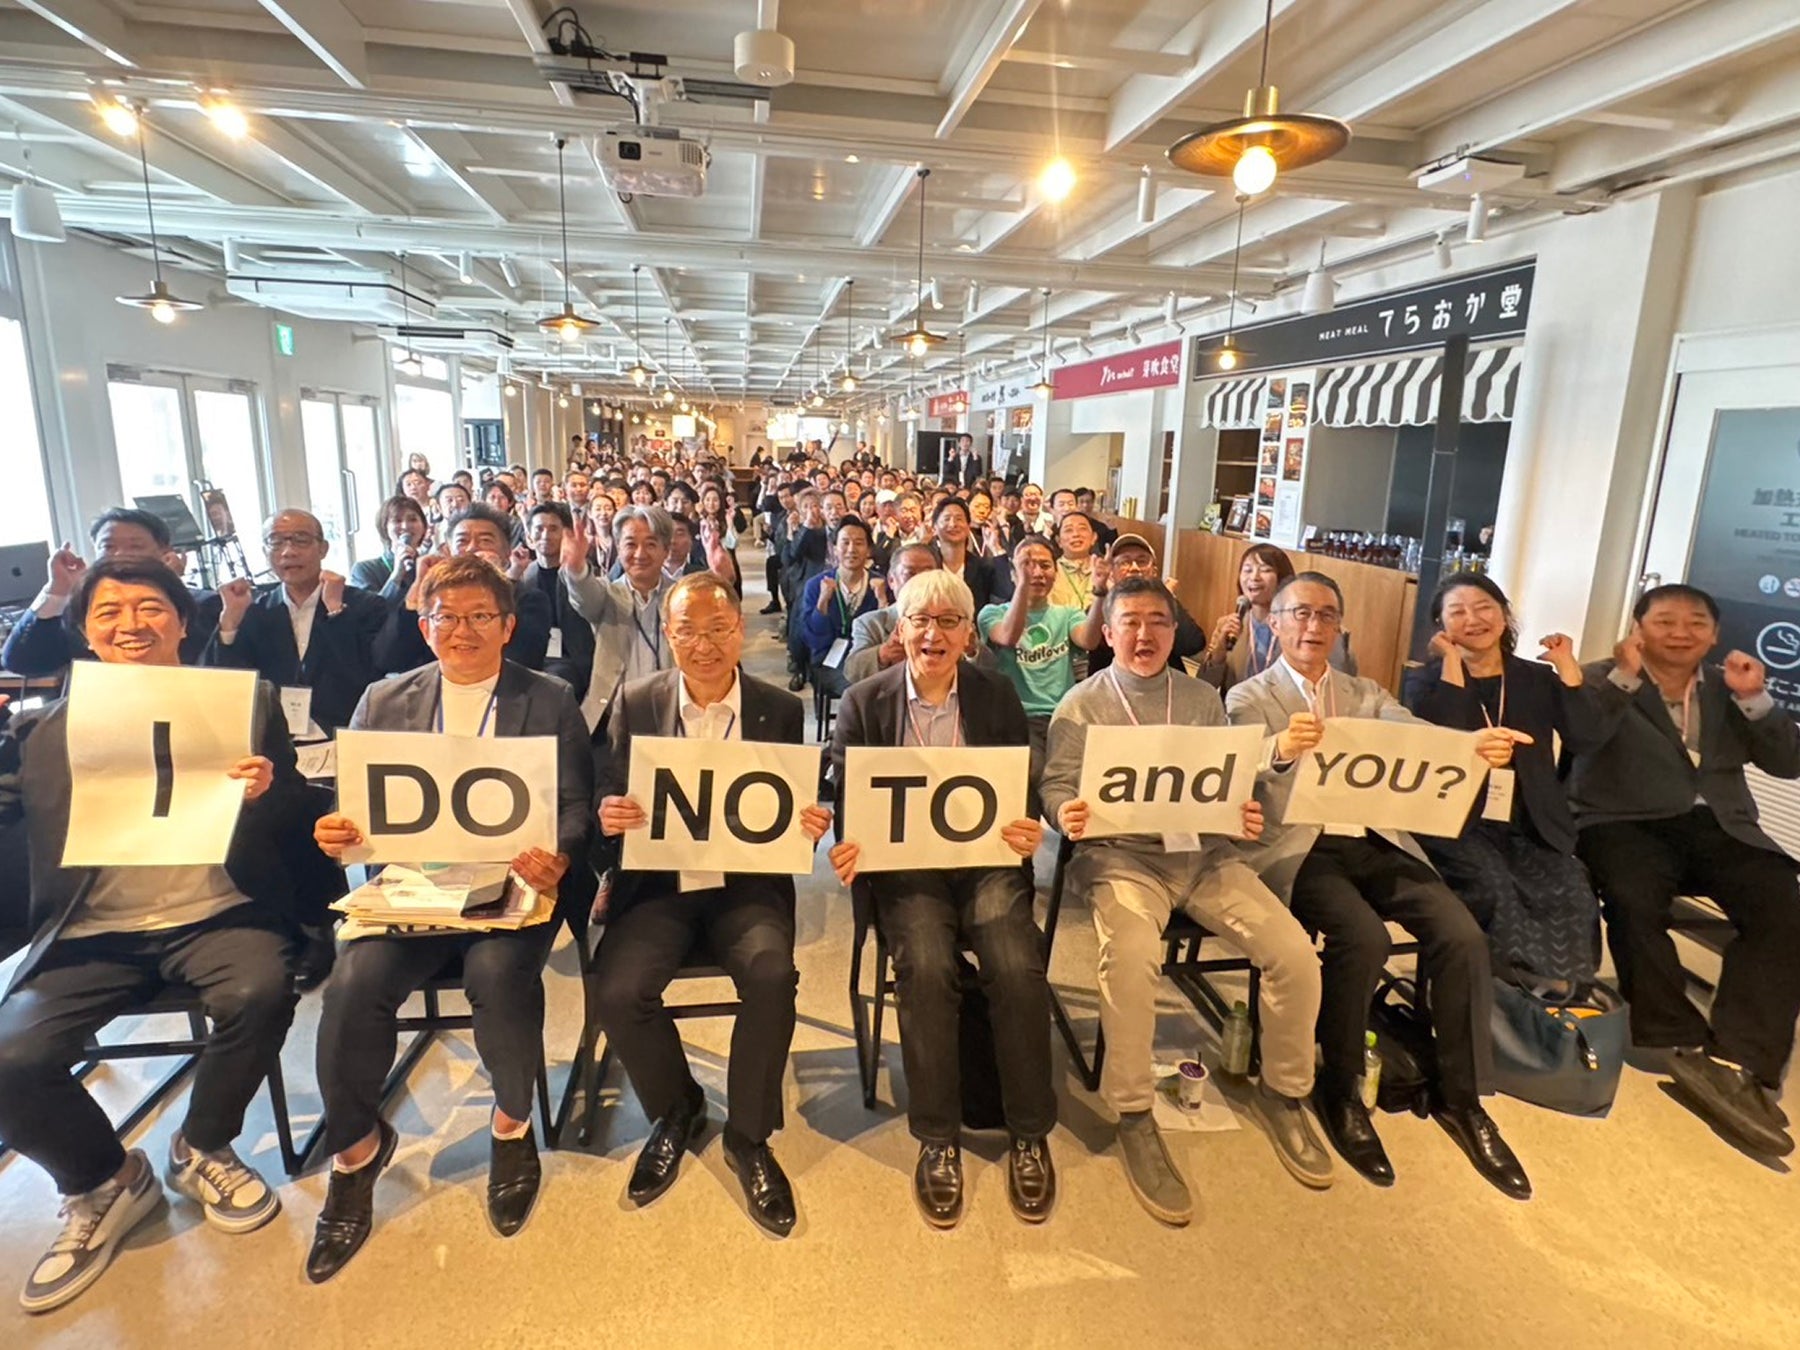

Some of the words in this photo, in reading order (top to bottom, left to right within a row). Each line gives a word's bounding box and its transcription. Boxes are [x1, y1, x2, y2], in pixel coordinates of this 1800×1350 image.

[1318, 328, 1341, 341] MEAT
[1344, 323, 1369, 337] MEAL
[1378, 283, 1523, 338] てらおか堂
[1751, 487, 1800, 507] 加熱
[152, 721, 174, 817] I
[1098, 753, 1237, 803] and
[1313, 751, 1467, 799] YOU?
[367, 763, 530, 837] DO
[650, 767, 793, 844] NO
[870, 775, 998, 843] TO
